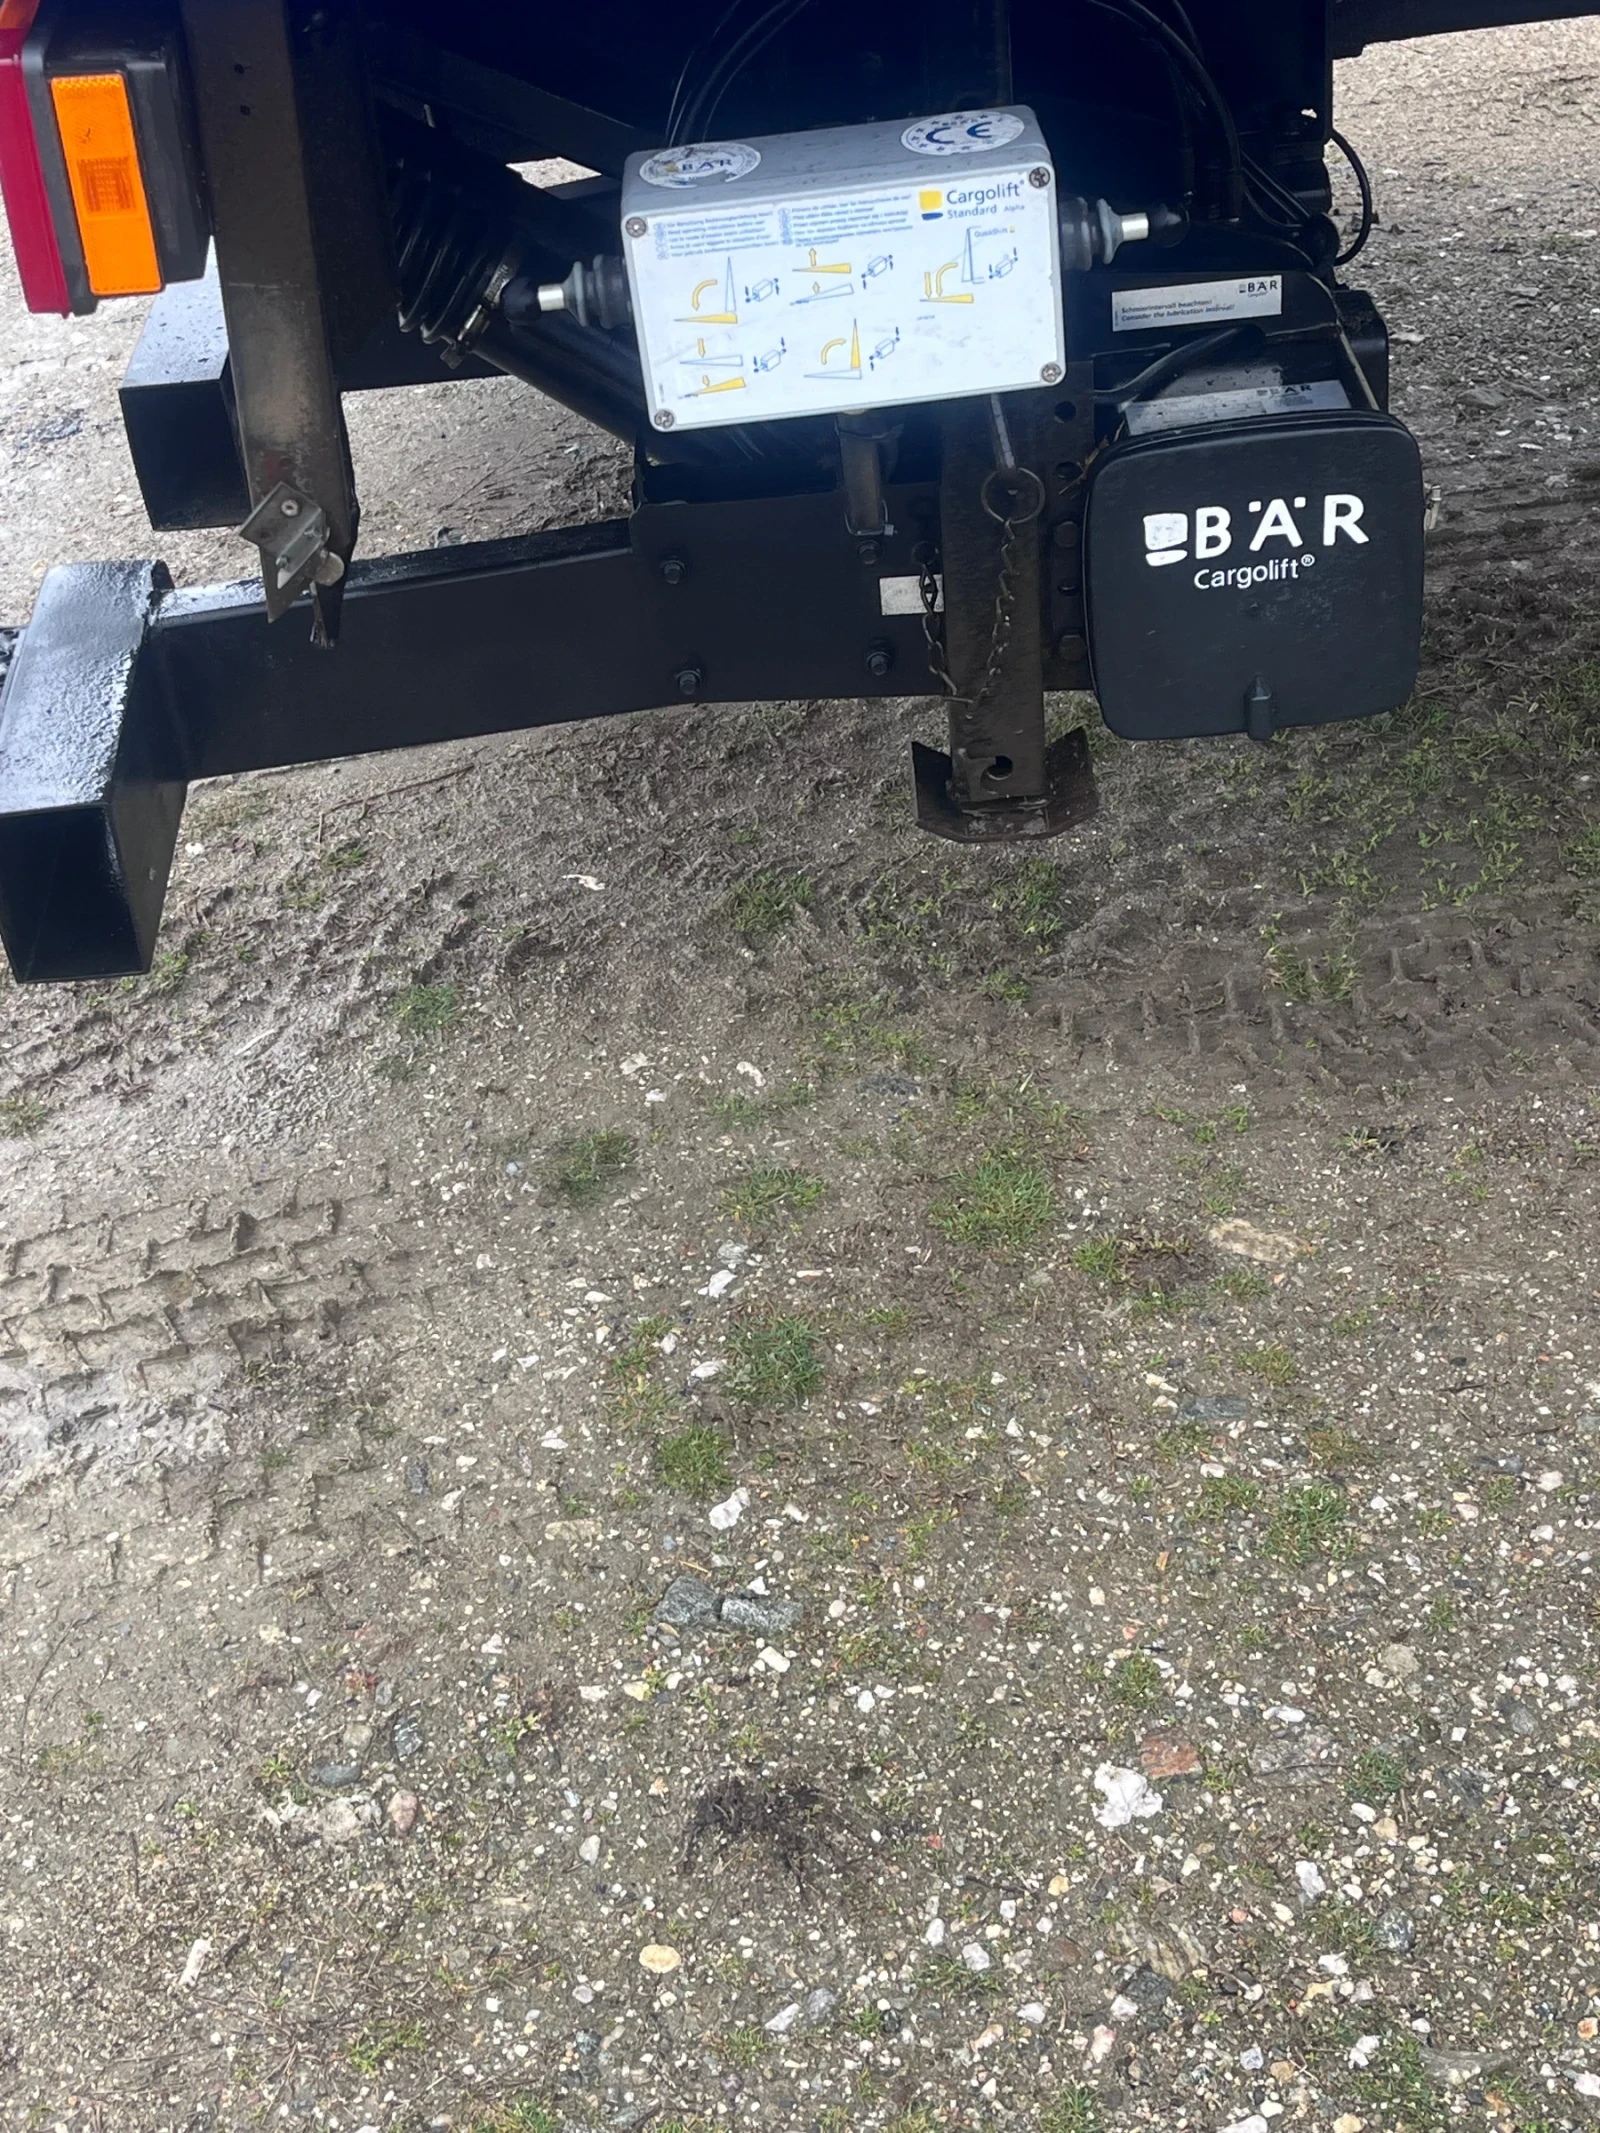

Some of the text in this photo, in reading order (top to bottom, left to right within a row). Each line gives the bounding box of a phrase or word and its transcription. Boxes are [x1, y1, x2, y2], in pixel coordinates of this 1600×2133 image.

[925, 121, 993, 144] CE
[947, 204, 997, 219] Standard
[1248, 279, 1278, 292] BÄR
[1195, 494, 1370, 560] BÄR
